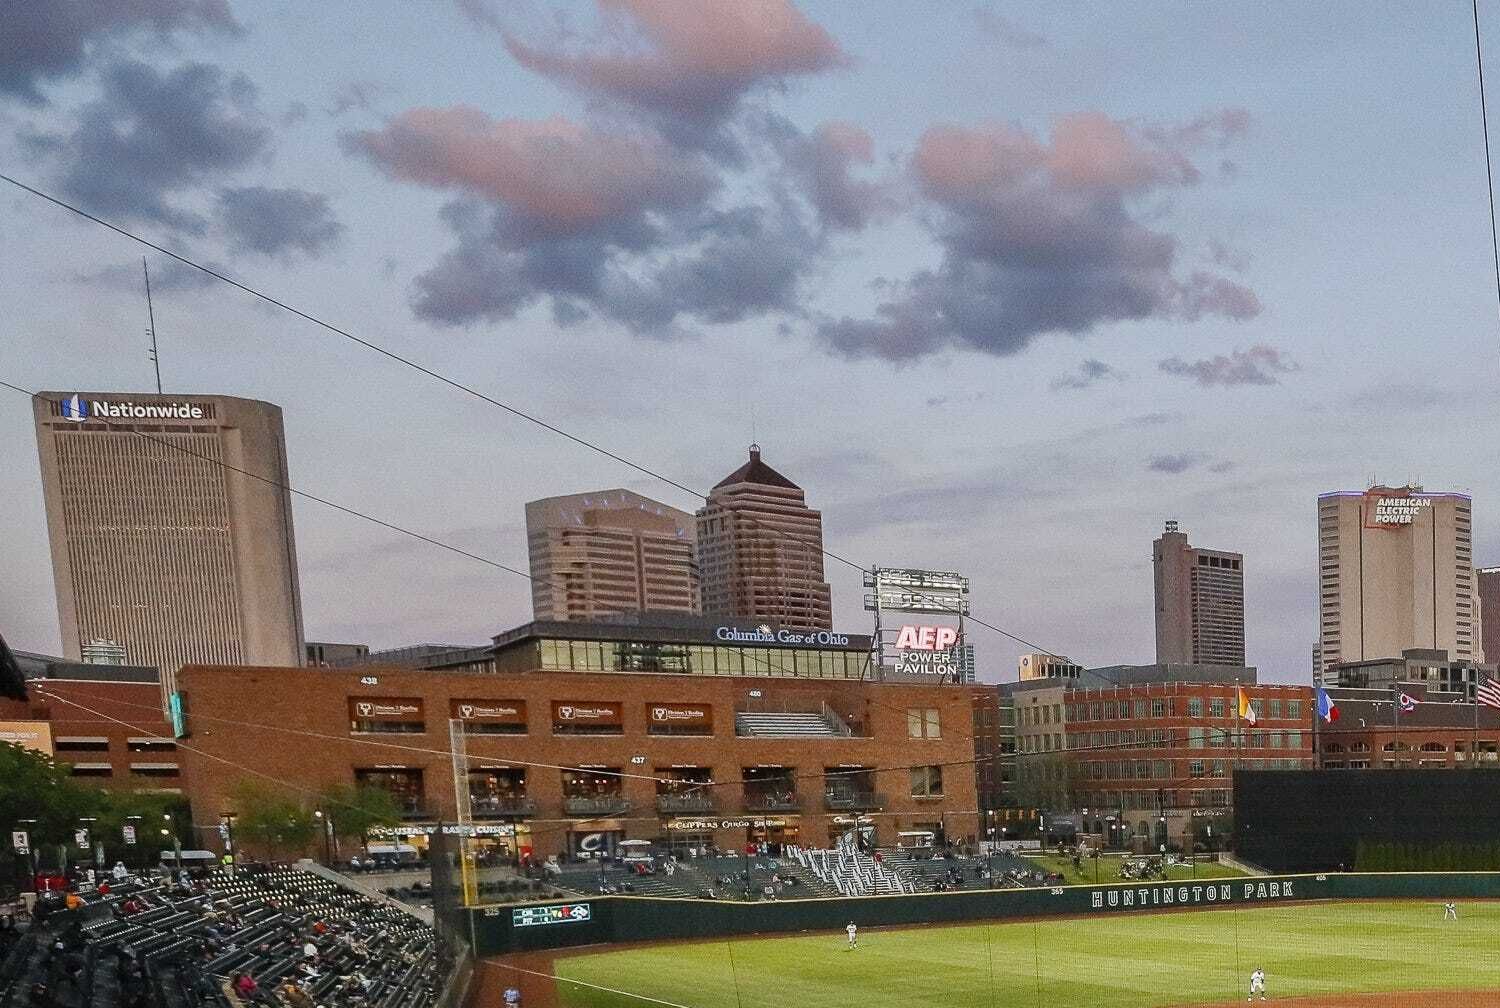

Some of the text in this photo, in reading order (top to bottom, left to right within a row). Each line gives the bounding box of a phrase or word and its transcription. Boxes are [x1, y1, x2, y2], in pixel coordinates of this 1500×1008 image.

[93, 401, 202, 418] Nationwide
[1377, 498, 1431, 507] AMERICAN
[1376, 506, 1420, 515] ELECTRIC
[1375, 514, 1412, 524] POWER
[716, 627, 849, 646] Columbia Gas of Ohio
[895, 625, 956, 650] AEP
[900, 652, 951, 664] POWER
[894, 664, 957, 675] PAVILION
[1091, 881, 1294, 908] HUNTINGTON PARK
